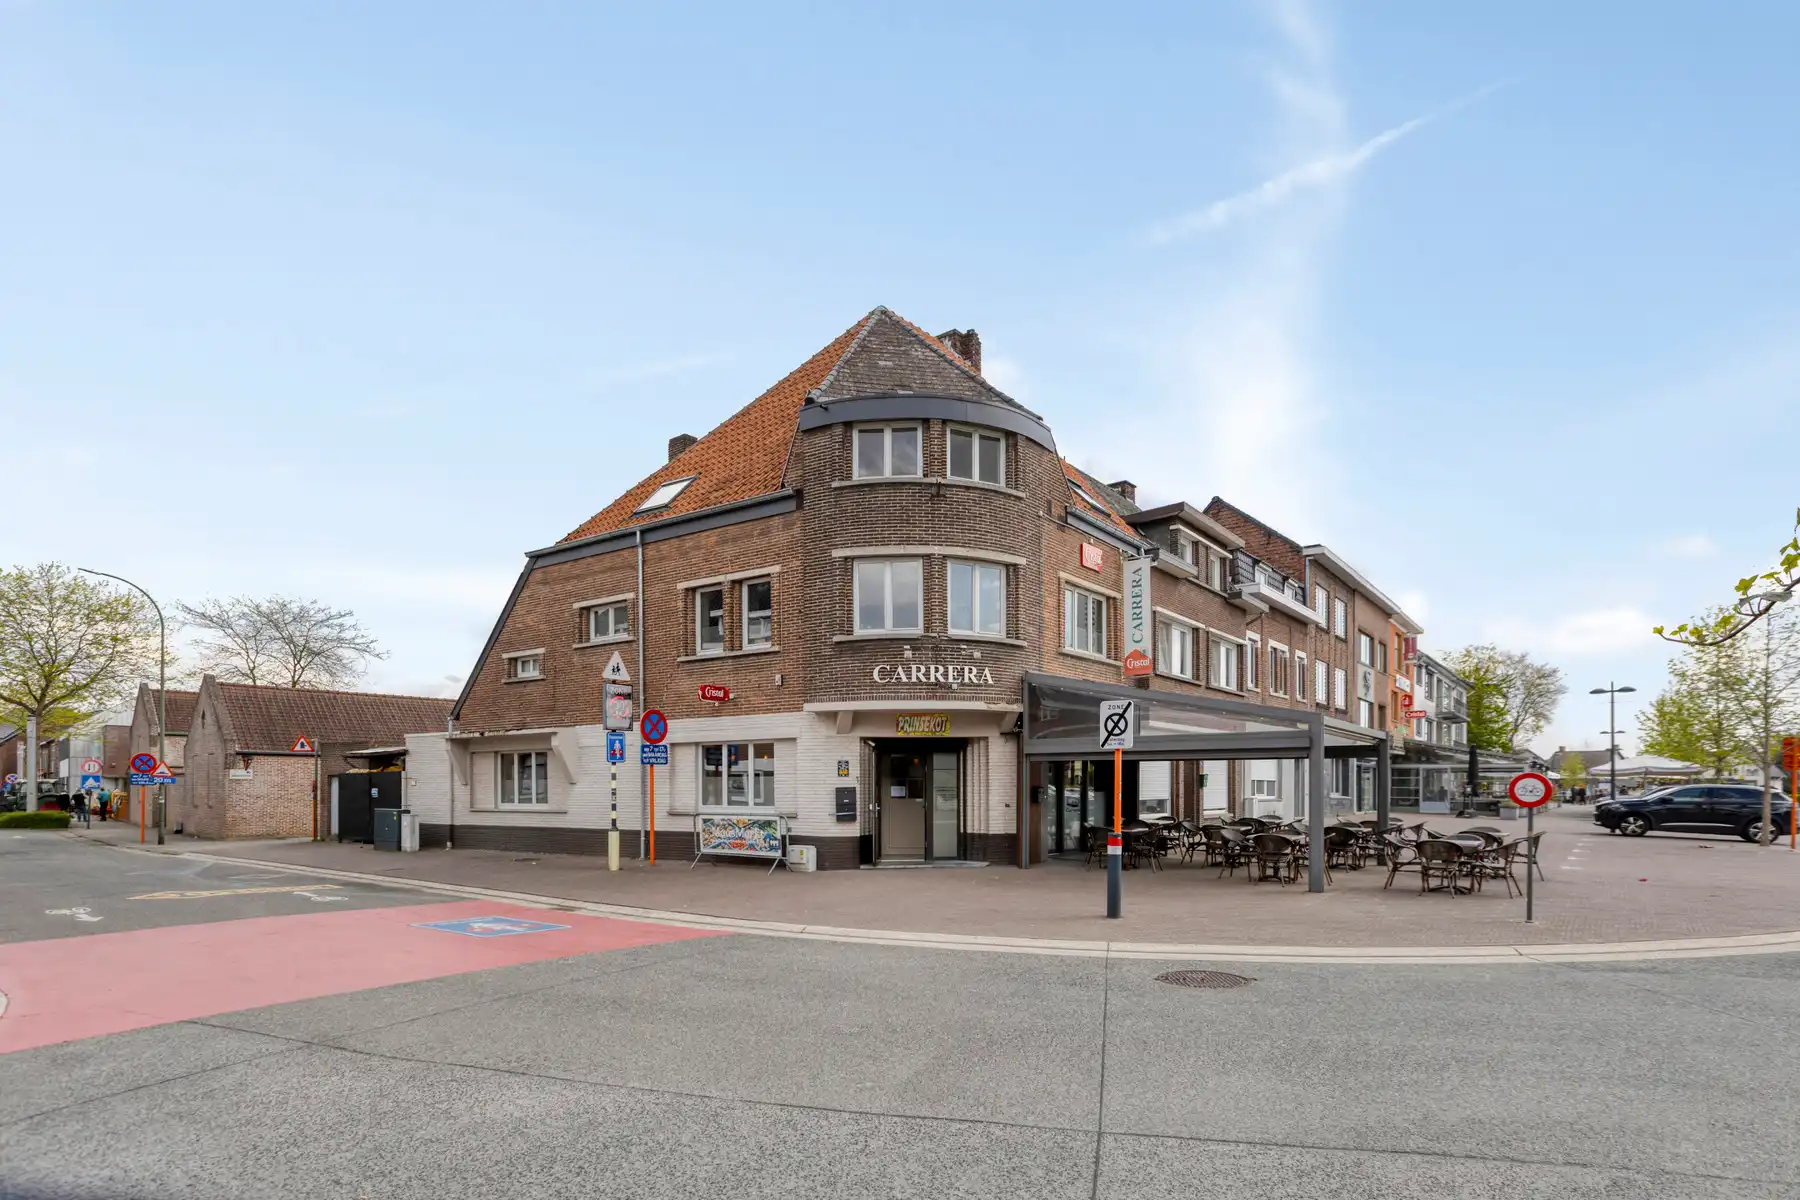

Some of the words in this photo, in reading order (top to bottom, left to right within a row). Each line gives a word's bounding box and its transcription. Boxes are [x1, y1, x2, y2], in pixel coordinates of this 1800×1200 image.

[1132, 567, 1143, 643] CARRERA
[1126, 657, 1150, 669] Cristal
[873, 664, 994, 684] CARRERA
[705, 686, 724, 698] Cristal
[898, 716, 948, 732] PRINSEKOT
